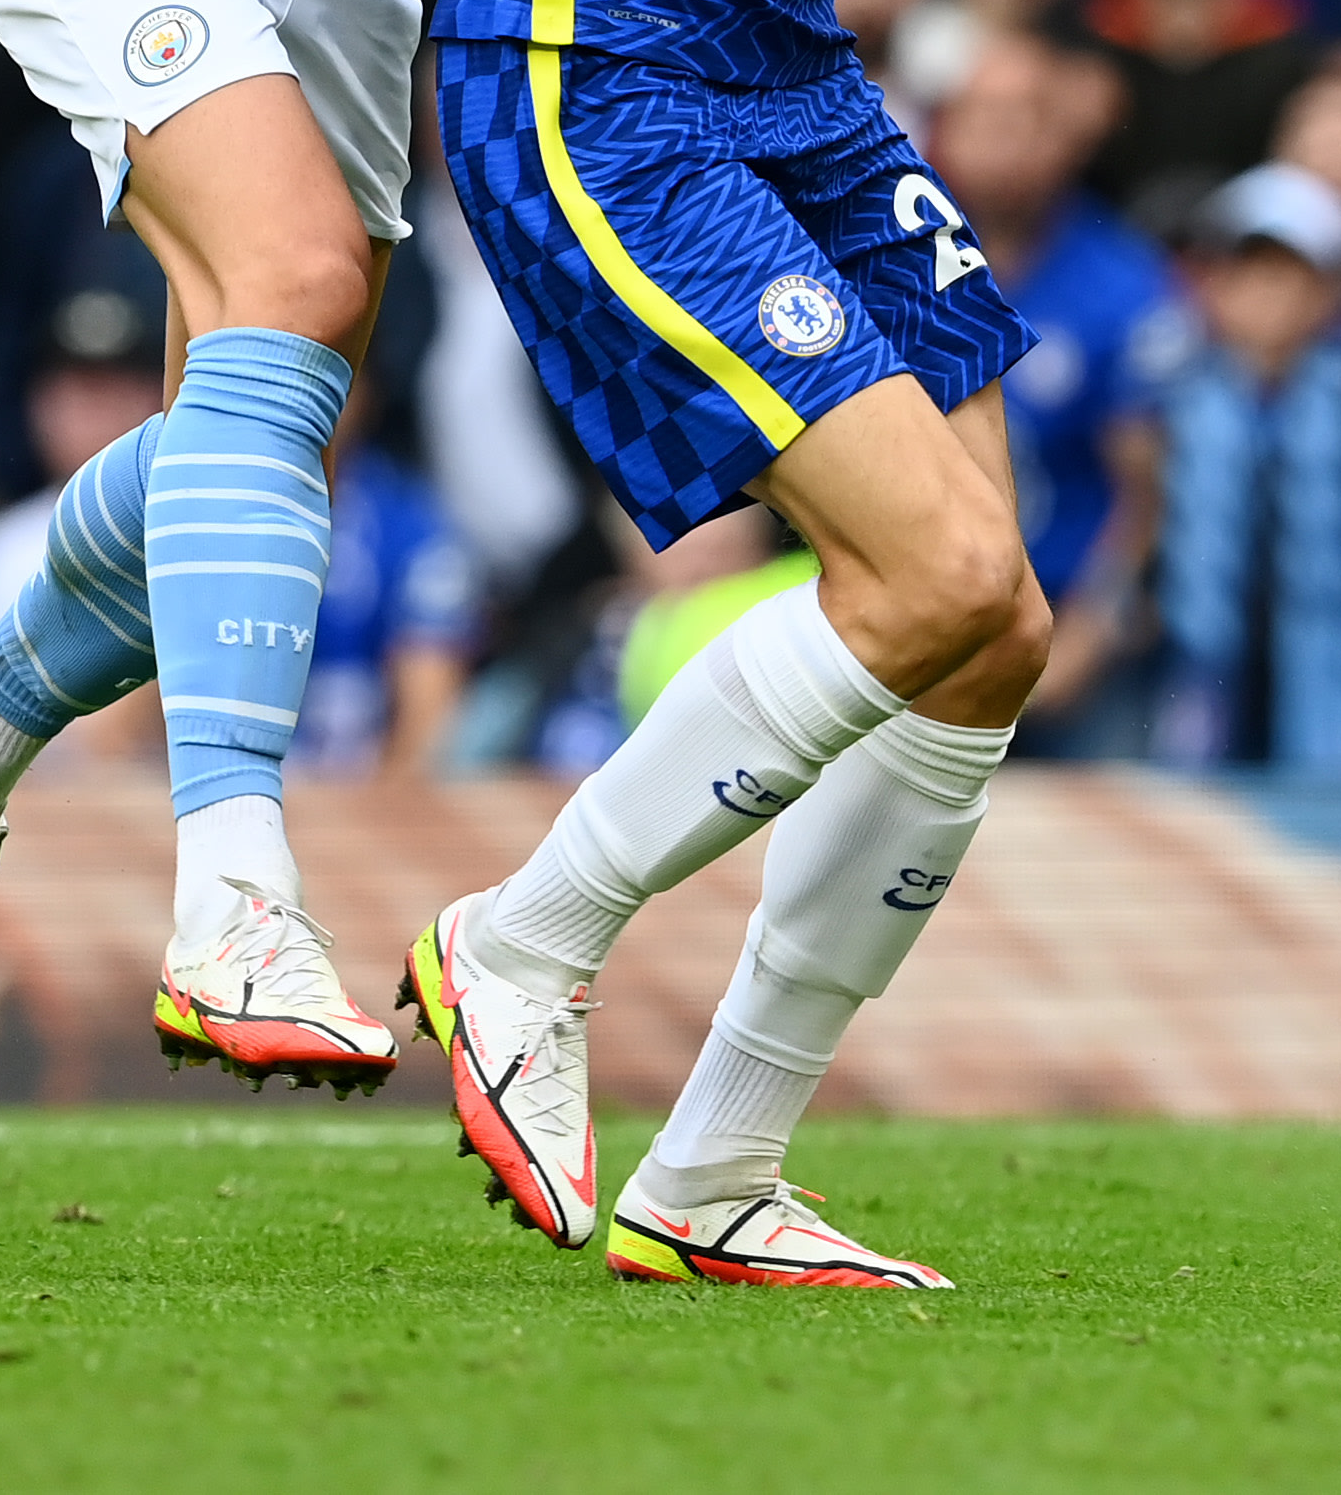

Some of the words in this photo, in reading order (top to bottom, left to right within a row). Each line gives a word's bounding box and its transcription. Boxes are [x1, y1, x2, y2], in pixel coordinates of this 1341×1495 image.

[130, 10, 193, 55] MANCHESTER
[163, 59, 187, 77] CITY
[893, 173, 988, 293] 2
[761, 277, 806, 313] CHELSEA
[797, 335, 835, 353] FOOTBALL
[215, 617, 312, 653] CITY
